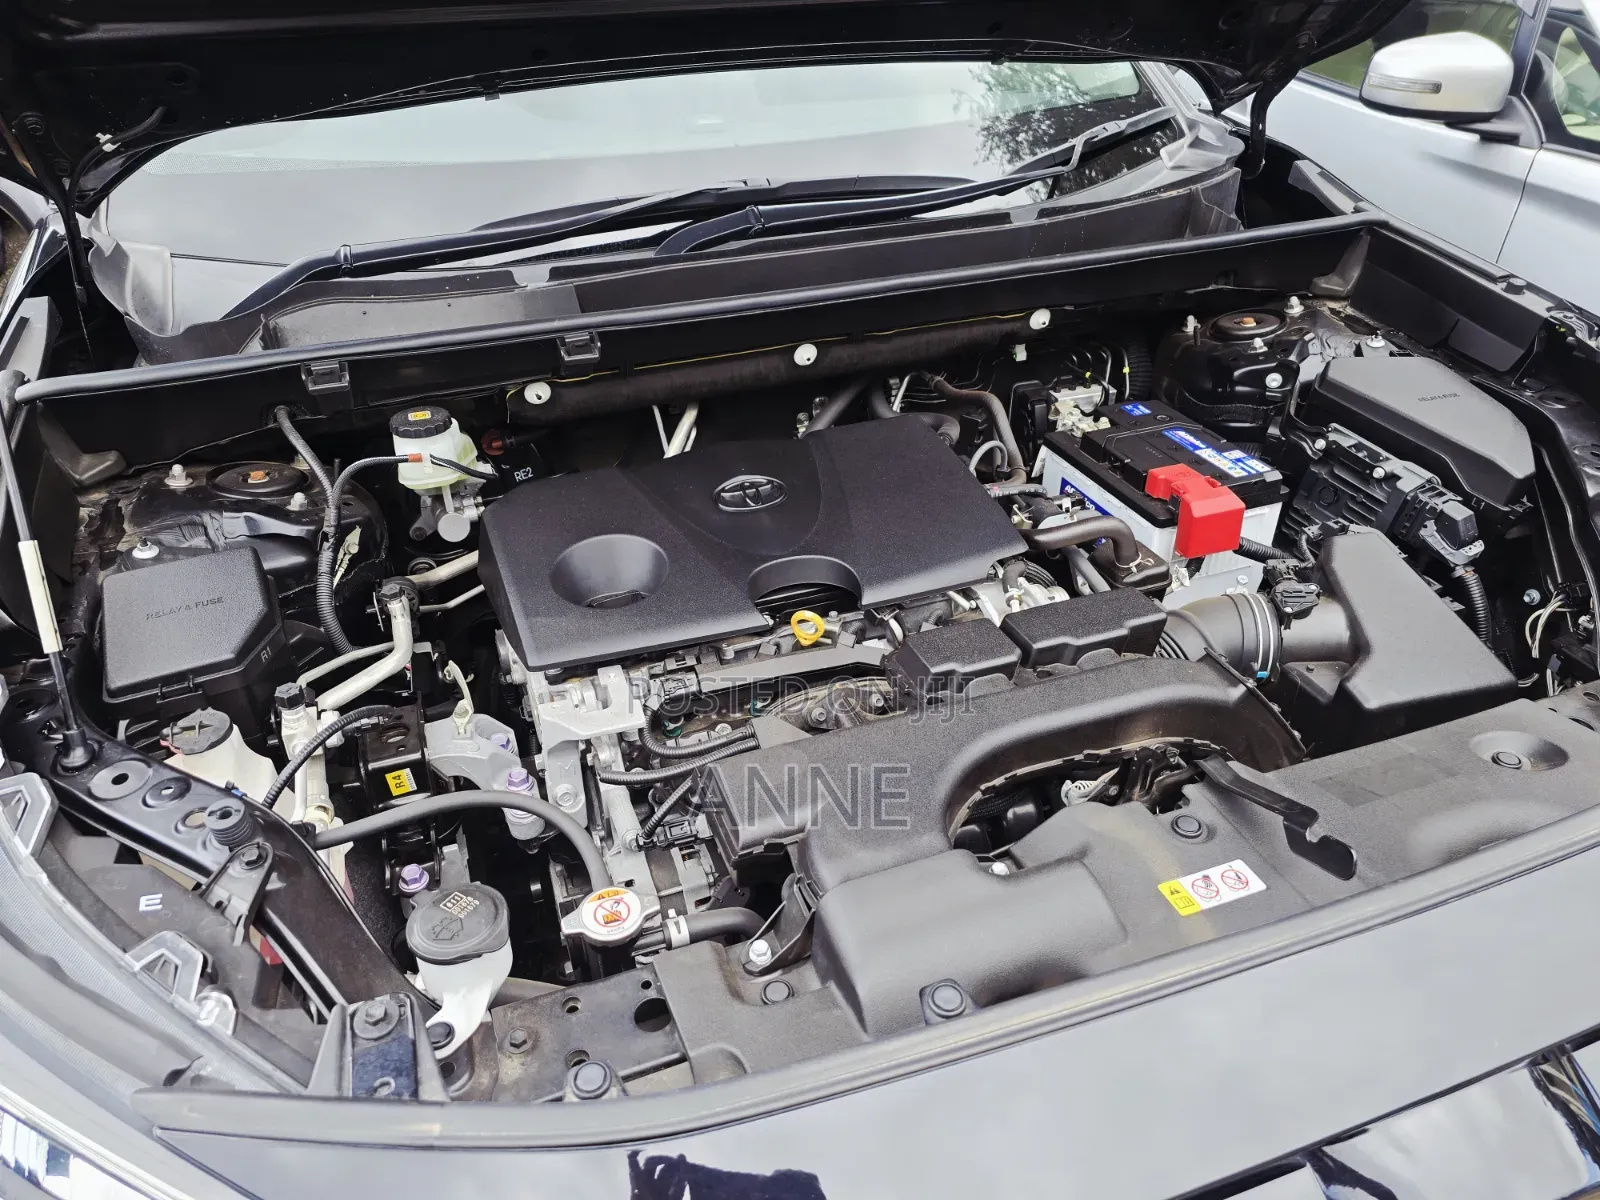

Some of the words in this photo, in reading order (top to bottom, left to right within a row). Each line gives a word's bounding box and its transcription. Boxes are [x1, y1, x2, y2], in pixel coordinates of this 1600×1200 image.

[514, 467, 534, 482] RE2
[1471, 497, 1485, 510] L1
[146, 606, 182, 621] RELAY
[195, 597, 224, 608] FUSE
[261, 646, 272, 662] R1
[391, 774, 406, 790] R4
[139, 894, 163, 912] E
